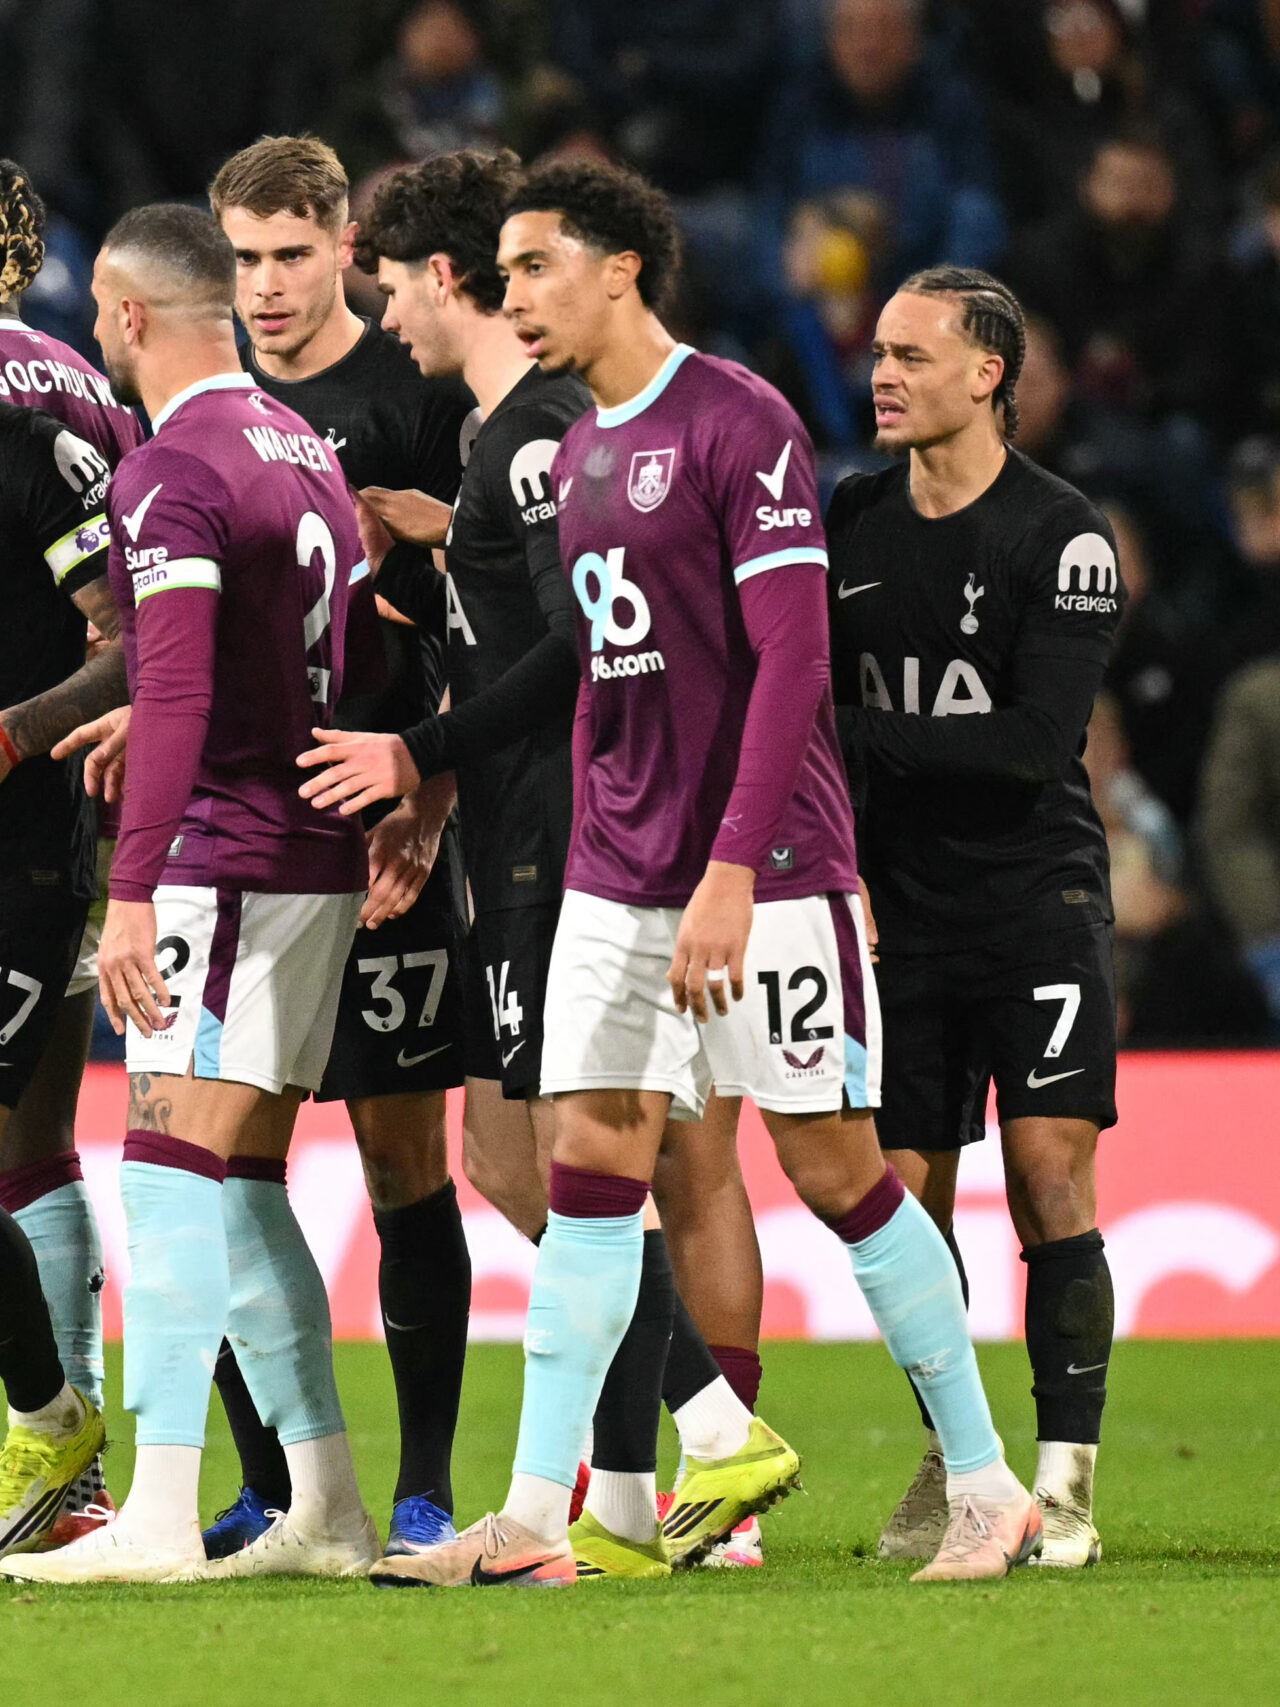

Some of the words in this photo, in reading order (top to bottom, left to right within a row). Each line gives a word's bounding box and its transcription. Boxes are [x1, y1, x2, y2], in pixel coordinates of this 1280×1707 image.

[243, 426, 332, 472] WALKER
[755, 505, 812, 531] Sure
[125, 546, 169, 571] Sure
[296, 511, 336, 704] 2
[572, 547, 651, 653] 96
[1055, 594, 1117, 613] kraken
[591, 650, 665, 682] 96.com
[859, 652, 992, 717] AIA
[358, 948, 448, 1033] 37
[486, 960, 523, 1040] 14
[757, 965, 834, 1044] 12
[1033, 983, 1081, 1058] 7
